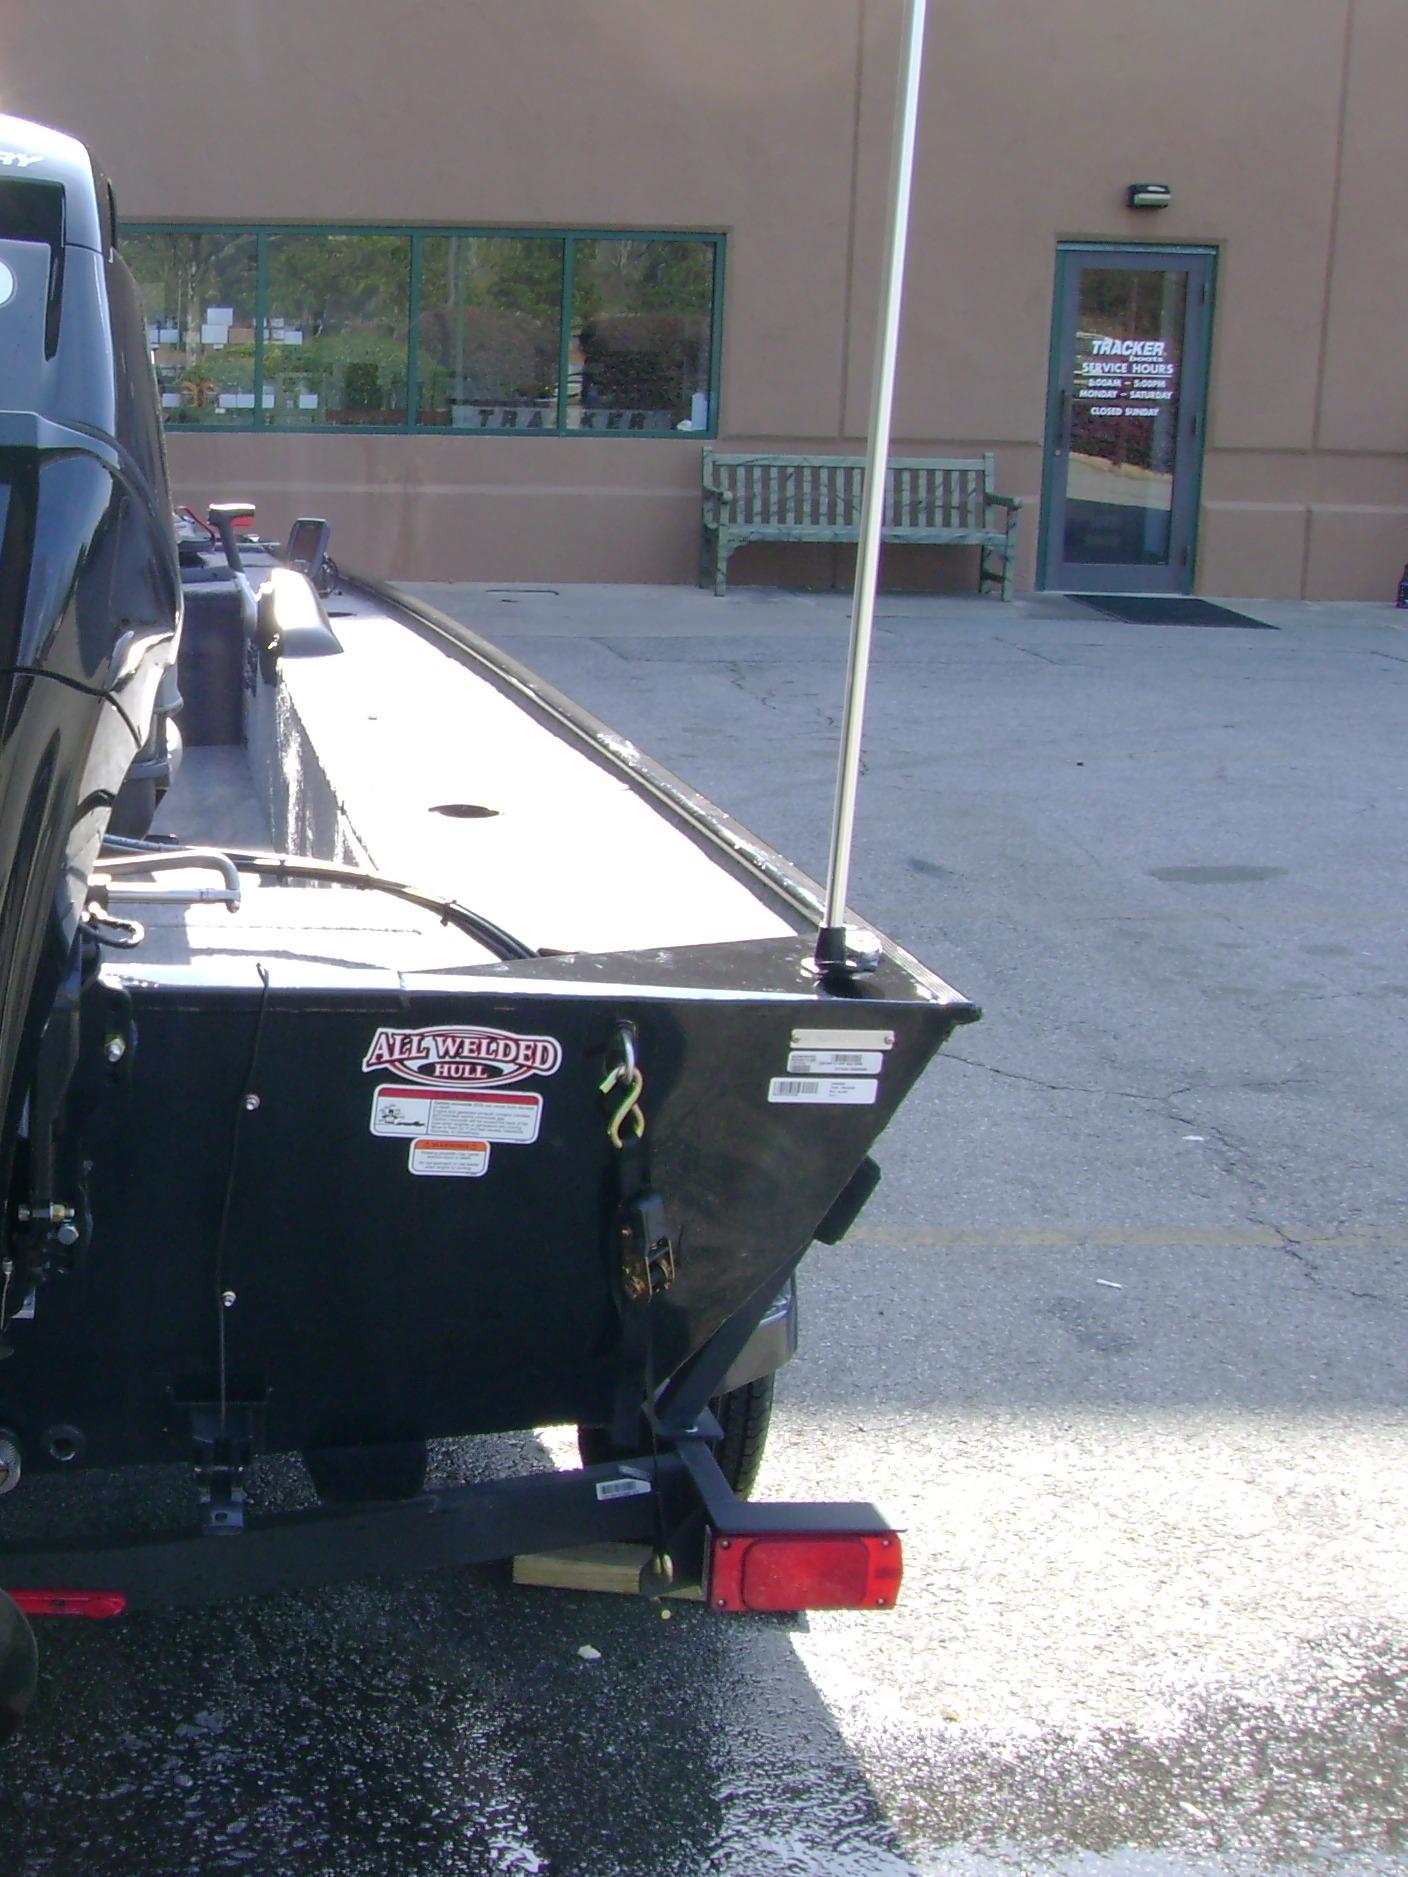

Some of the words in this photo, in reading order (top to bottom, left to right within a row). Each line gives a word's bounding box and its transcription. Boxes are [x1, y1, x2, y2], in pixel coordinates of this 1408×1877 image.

[1092, 340, 1165, 356] TRACKER
[1082, 362, 1128, 373] SERVICE
[1132, 363, 1174, 374] HOURS
[1079, 390, 1118, 398] MONDAY
[1130, 391, 1173, 399] SATURDAY
[478, 409, 646, 429] TRAKER
[1090, 407, 1123, 415] CLOSED
[1125, 407, 1160, 416] SUNDAY
[369, 1032, 428, 1064] ALL
[433, 1035, 556, 1070] WELDED
[433, 1063, 488, 1078] HULL
